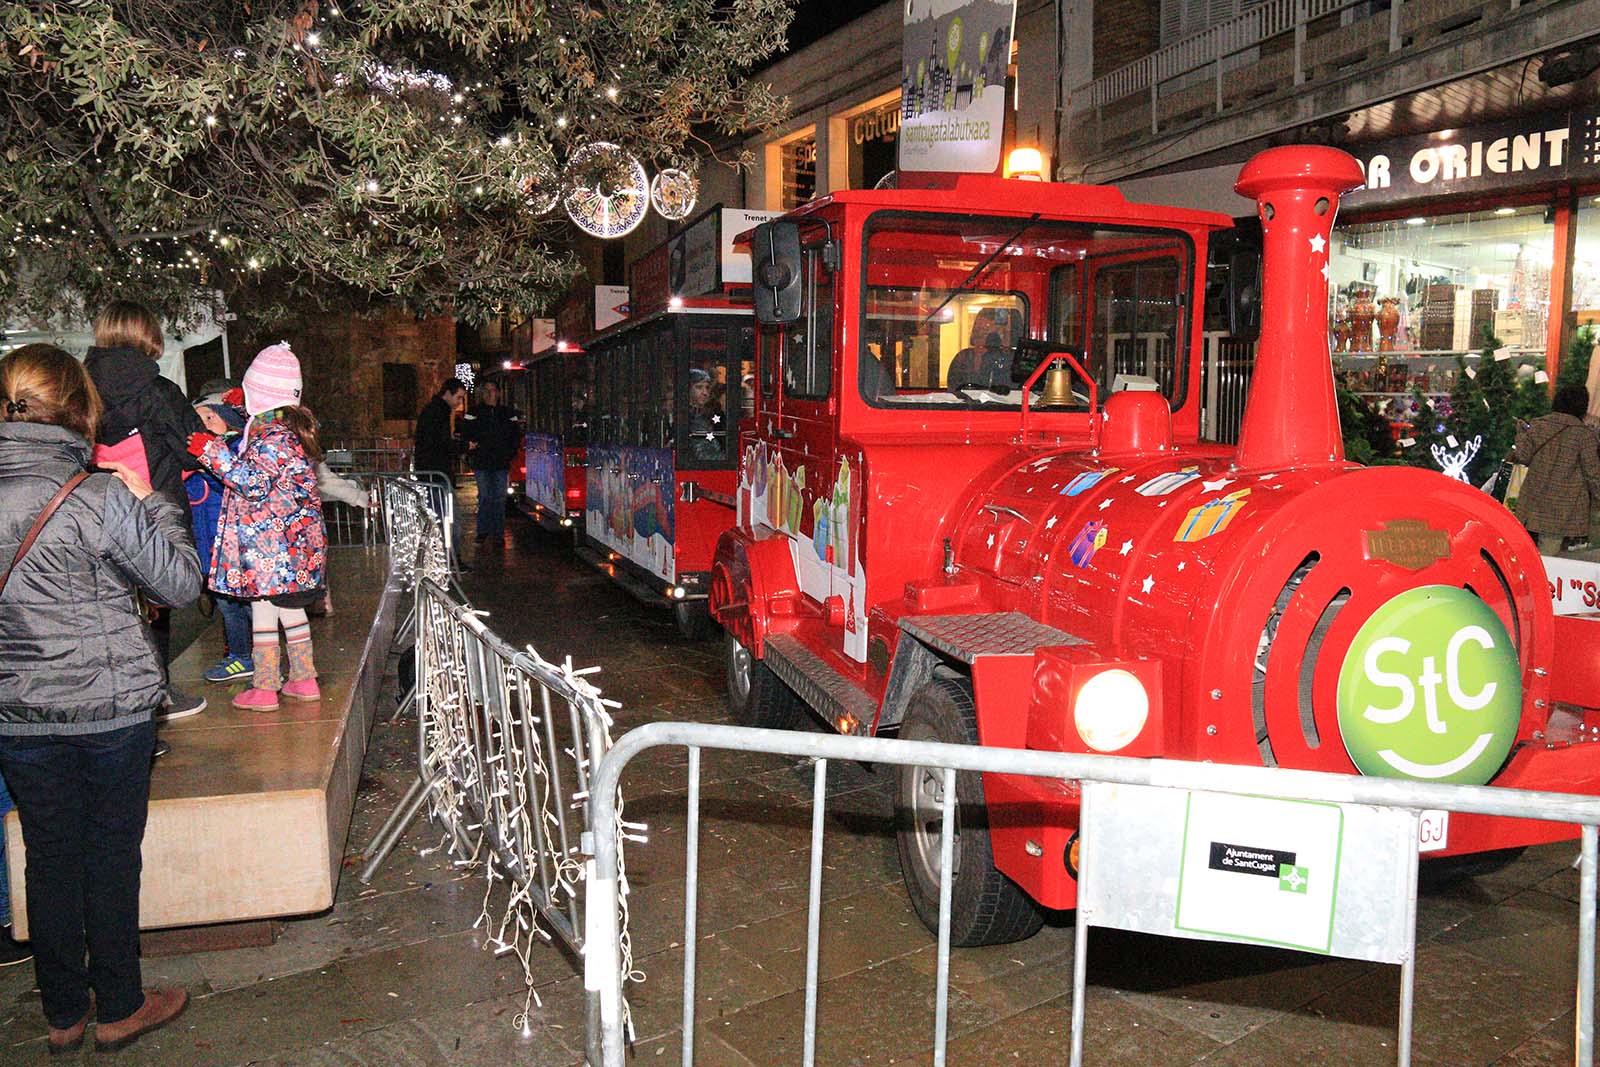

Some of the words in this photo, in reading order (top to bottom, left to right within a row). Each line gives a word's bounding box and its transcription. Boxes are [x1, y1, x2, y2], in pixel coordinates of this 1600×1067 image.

[1409, 127, 1570, 184] ORIENT
[744, 213, 767, 222] Trenet
[1362, 624, 1499, 735] StC
[1225, 847, 1275, 862] Ajuntament
[1221, 857, 1234, 866] de
[1234, 858, 1277, 872] SantCugat
